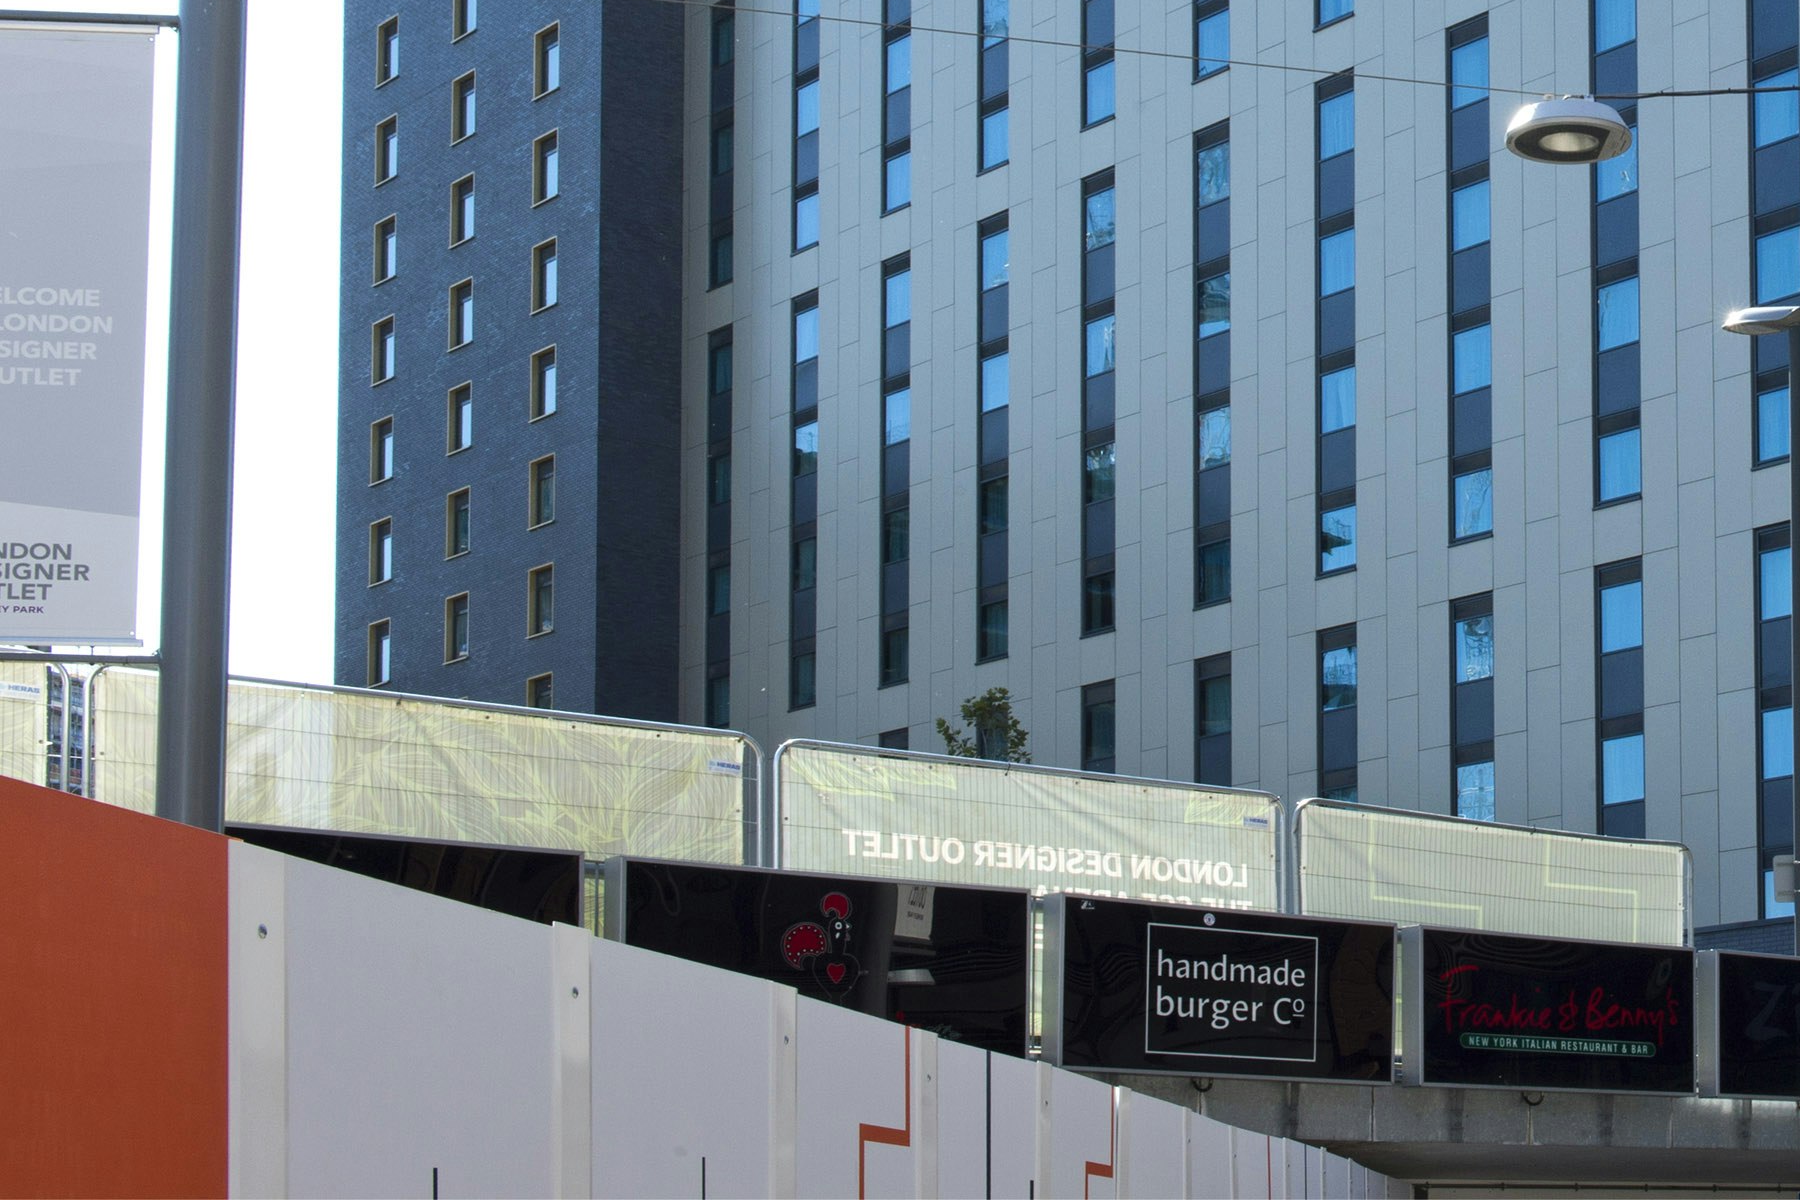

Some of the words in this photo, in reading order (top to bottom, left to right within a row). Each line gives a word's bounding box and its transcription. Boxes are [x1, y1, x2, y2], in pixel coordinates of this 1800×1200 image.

[0, 286, 100, 307] LCOME
[0, 312, 113, 334] ONDON
[0, 562, 90, 581] IGNER
[13, 605, 44, 614] PARK
[1157, 949, 1305, 987] handmade
[1156, 985, 1263, 1029] burger
[1438, 964, 1551, 1033] Frankie
[1558, 990, 1578, 1031] &
[1584, 985, 1679, 1047] Benny's
[1468, 1035, 1489, 1047] NEW
[1493, 1036, 1518, 1048] YORK
[1521, 1038, 1557, 1050] ITALIAN
[1560, 1040, 1618, 1053] RESTAURANT
[1621, 1043, 1628, 1053] &
[1631, 1044, 1649, 1054] BAR
